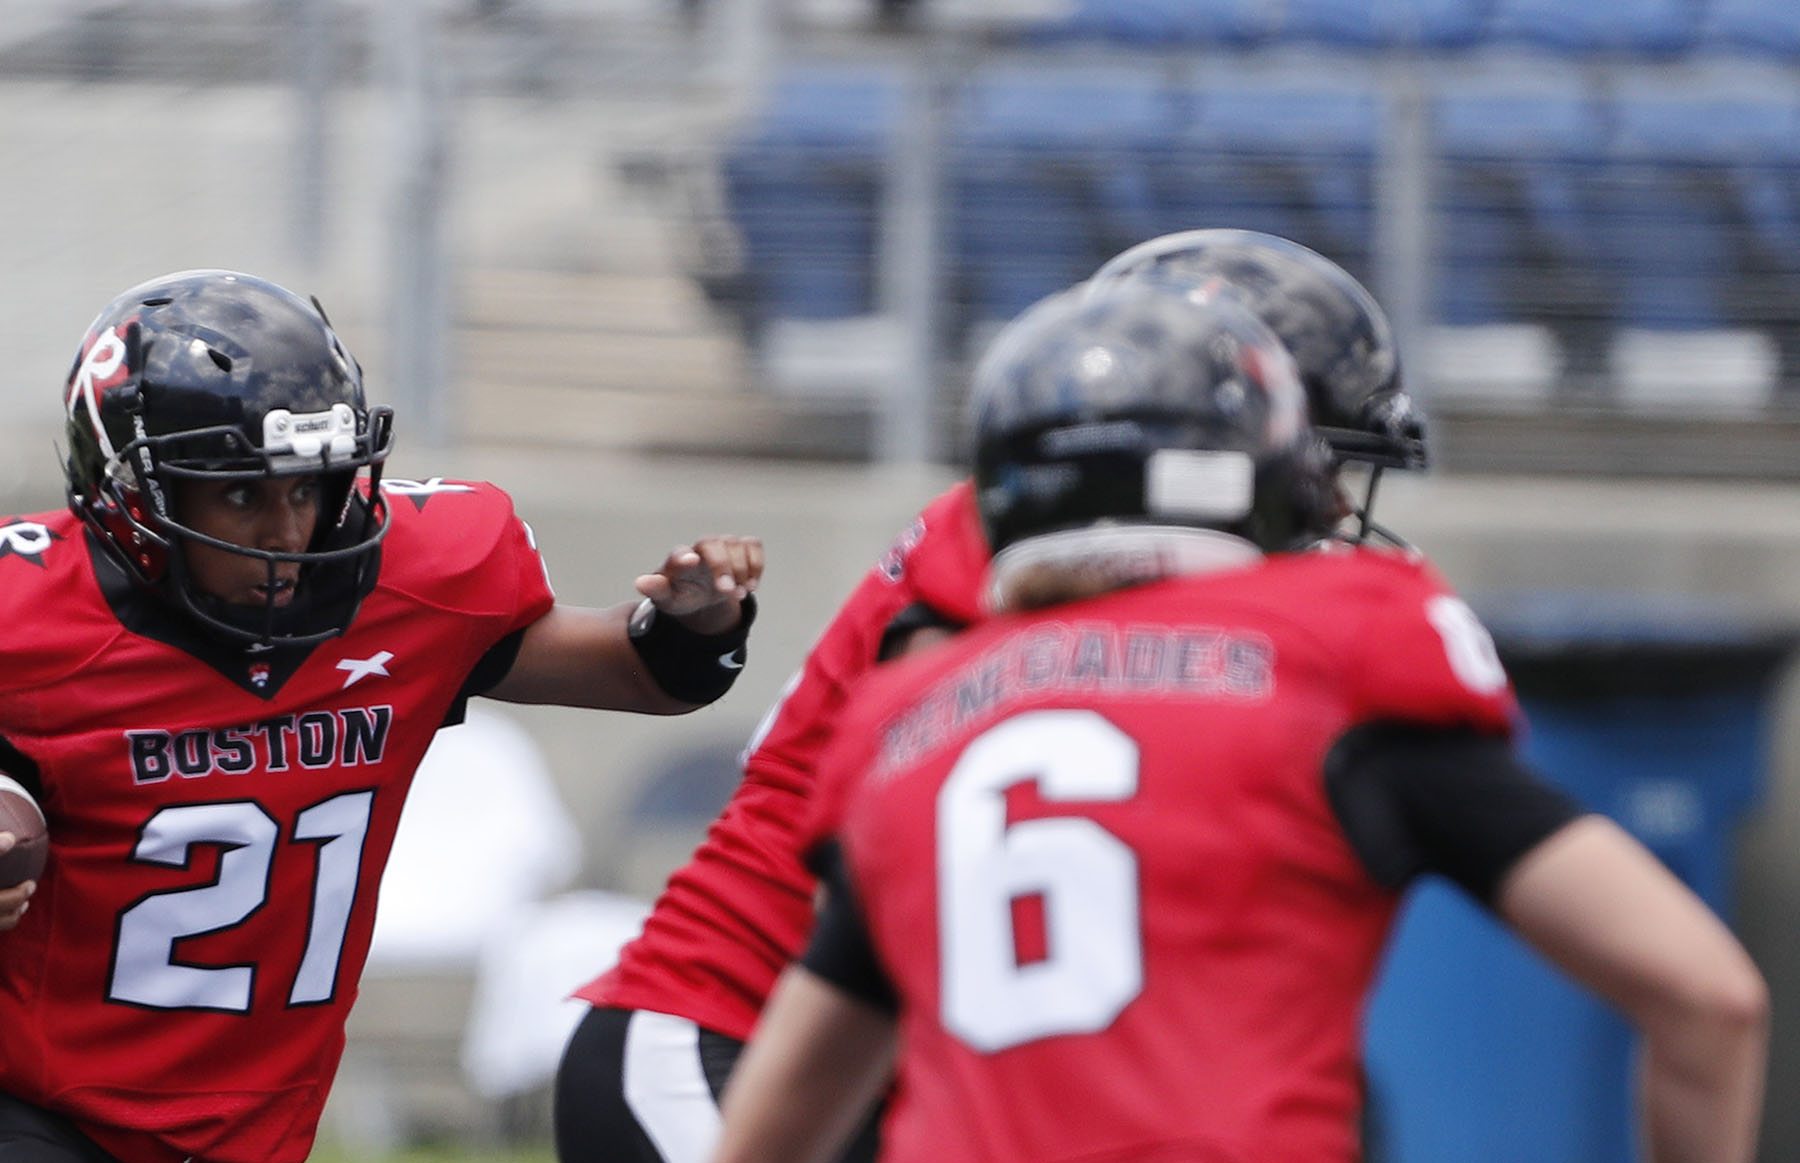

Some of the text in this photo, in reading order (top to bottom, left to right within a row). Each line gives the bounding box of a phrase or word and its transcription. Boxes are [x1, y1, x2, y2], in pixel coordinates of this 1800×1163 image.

[123, 704, 393, 786] BOSTON
[104, 785, 380, 1016] 21
[935, 708, 1144, 1055] 6
